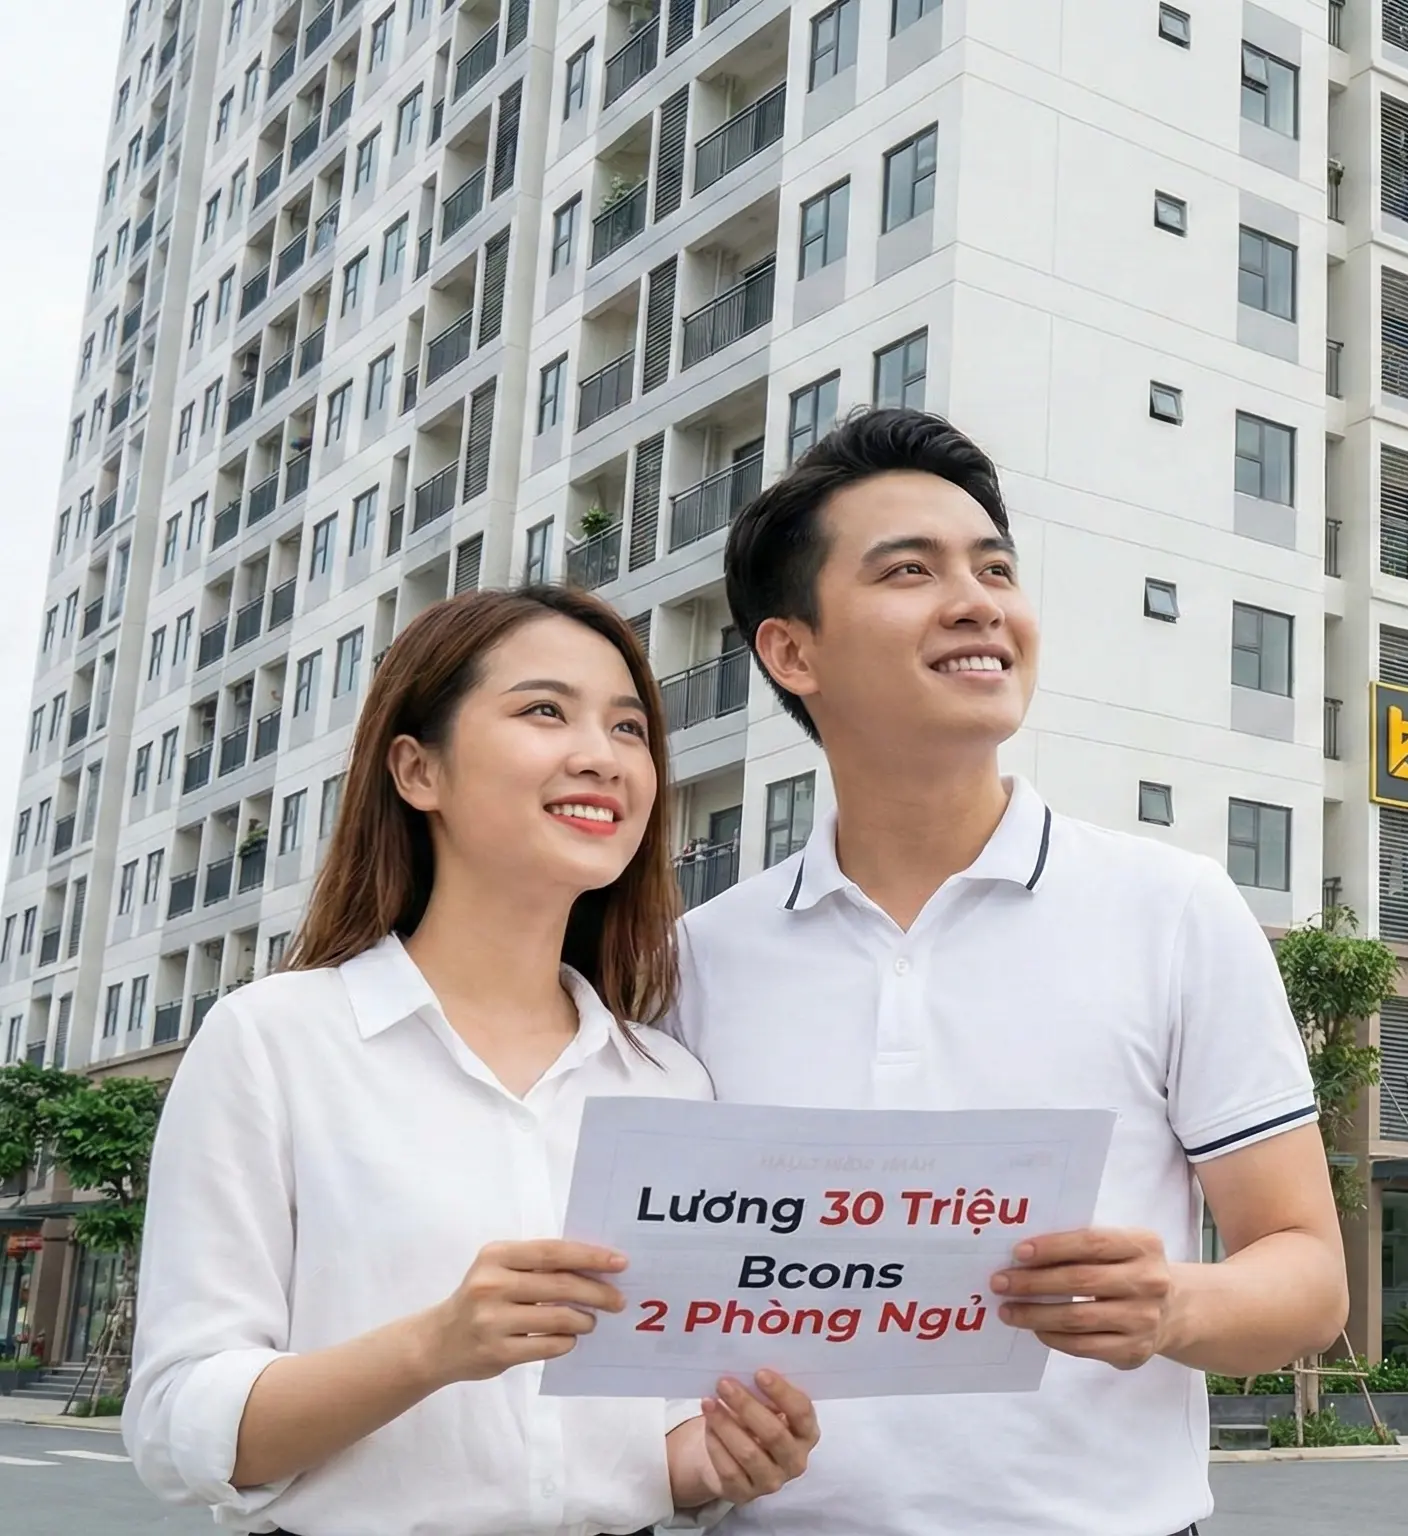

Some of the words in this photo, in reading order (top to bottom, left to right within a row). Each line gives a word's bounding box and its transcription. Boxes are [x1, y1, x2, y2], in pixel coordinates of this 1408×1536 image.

[637, 1186, 805, 1234] Lương
[819, 1191, 884, 1226] 30
[901, 1188, 1029, 1235] Triệu
[737, 1255, 905, 1289] Bcons
[635, 1300, 668, 1332] 2
[684, 1299, 862, 1343] Phòng
[878, 1294, 987, 1341] Ngủ
